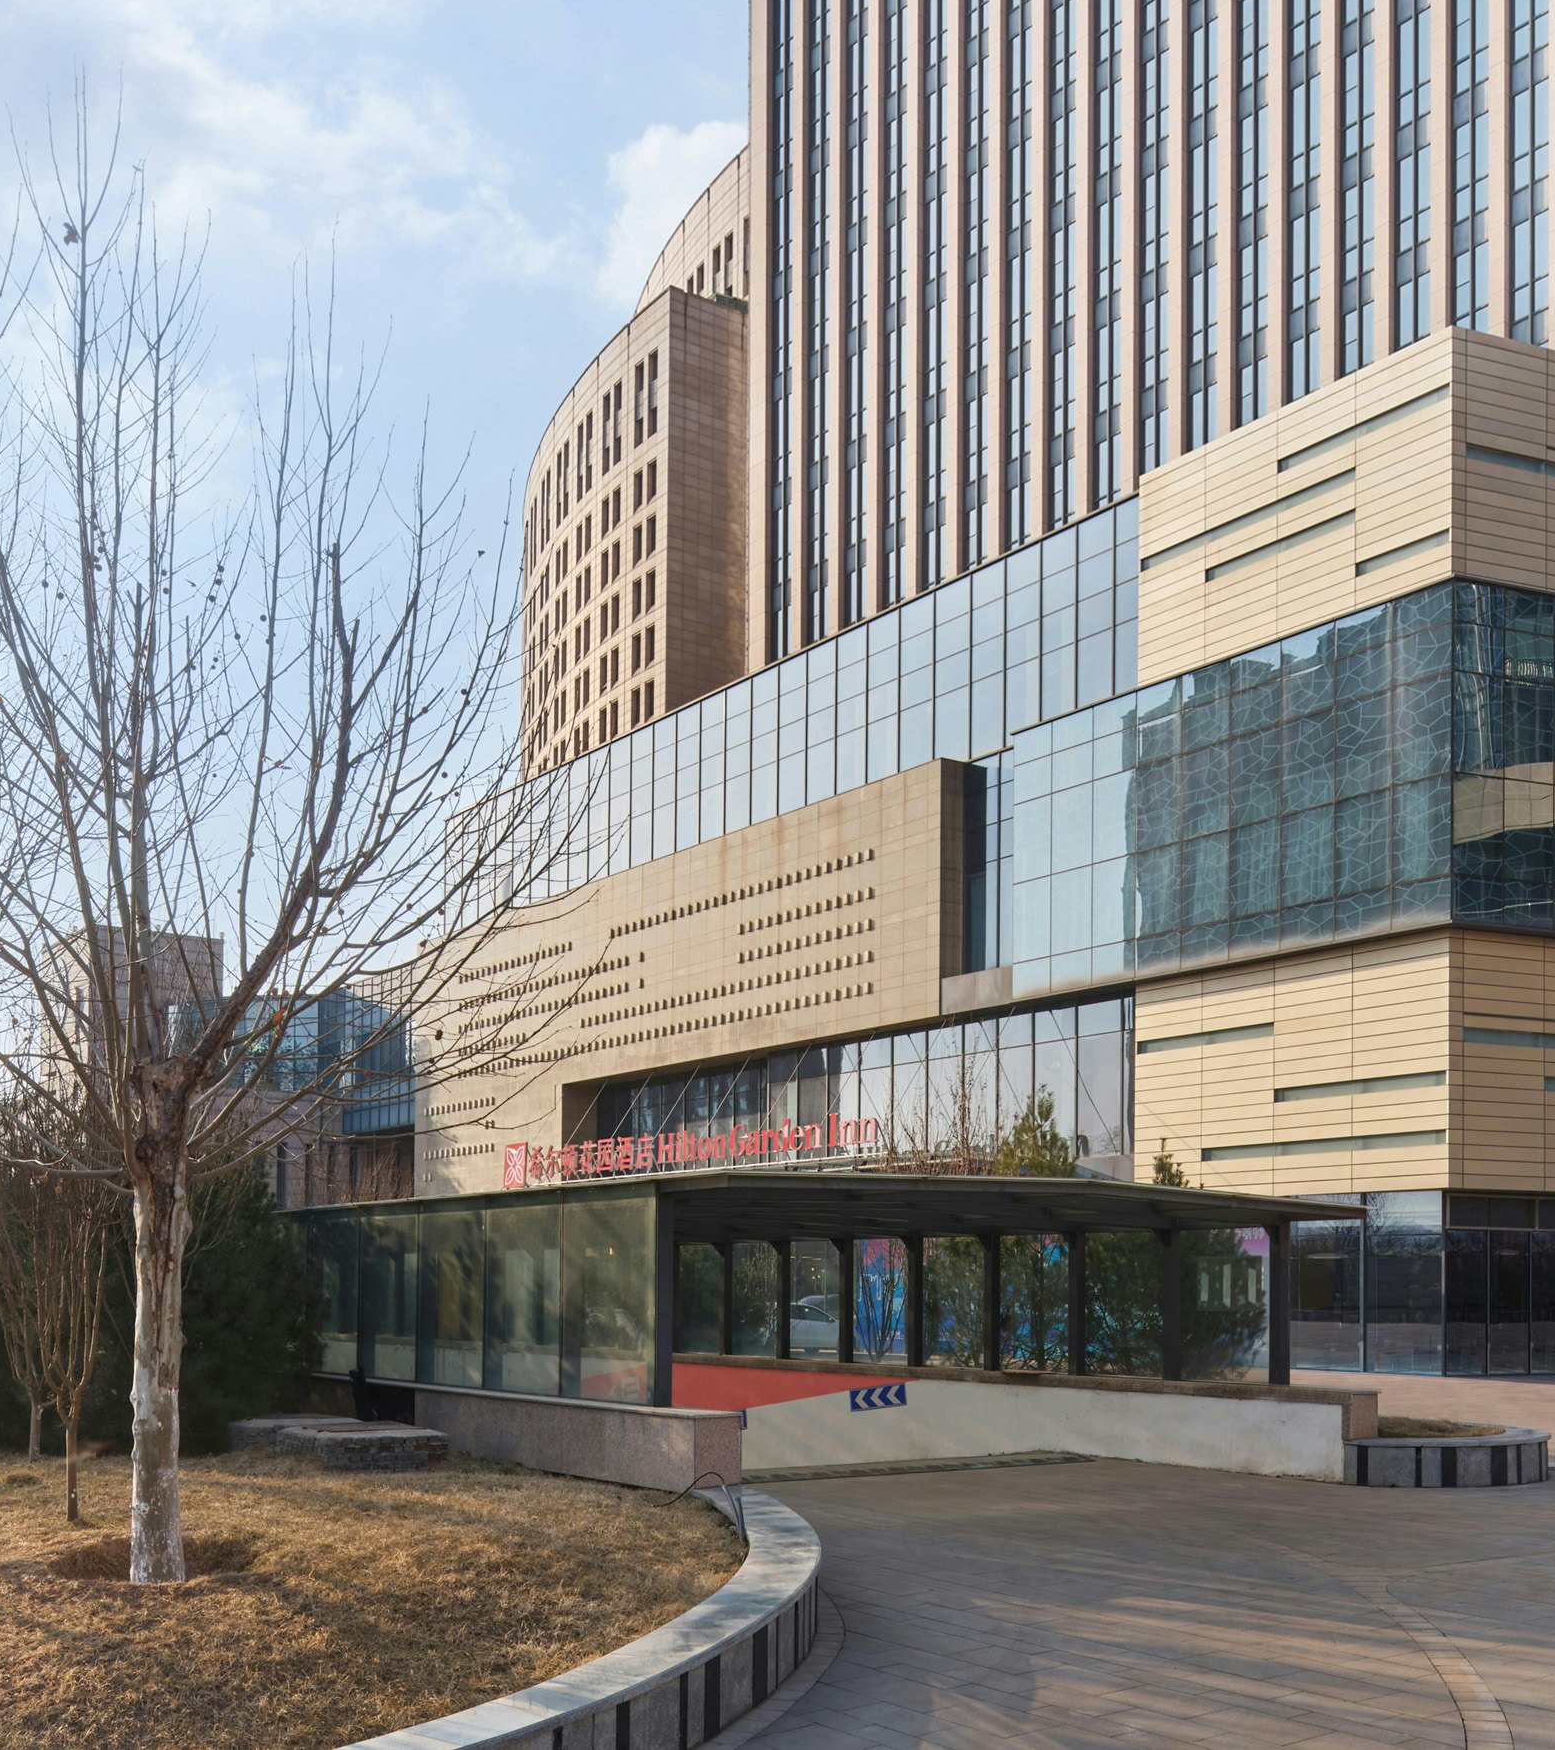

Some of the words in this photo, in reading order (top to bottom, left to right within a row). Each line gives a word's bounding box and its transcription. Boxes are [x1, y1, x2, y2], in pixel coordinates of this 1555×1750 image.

[528, 1133, 655, 1179] 希尔顿花园酒店
[657, 1130, 727, 1164] Hilton
[729, 1118, 822, 1158] Garden
[827, 1112, 878, 1147] Inn
